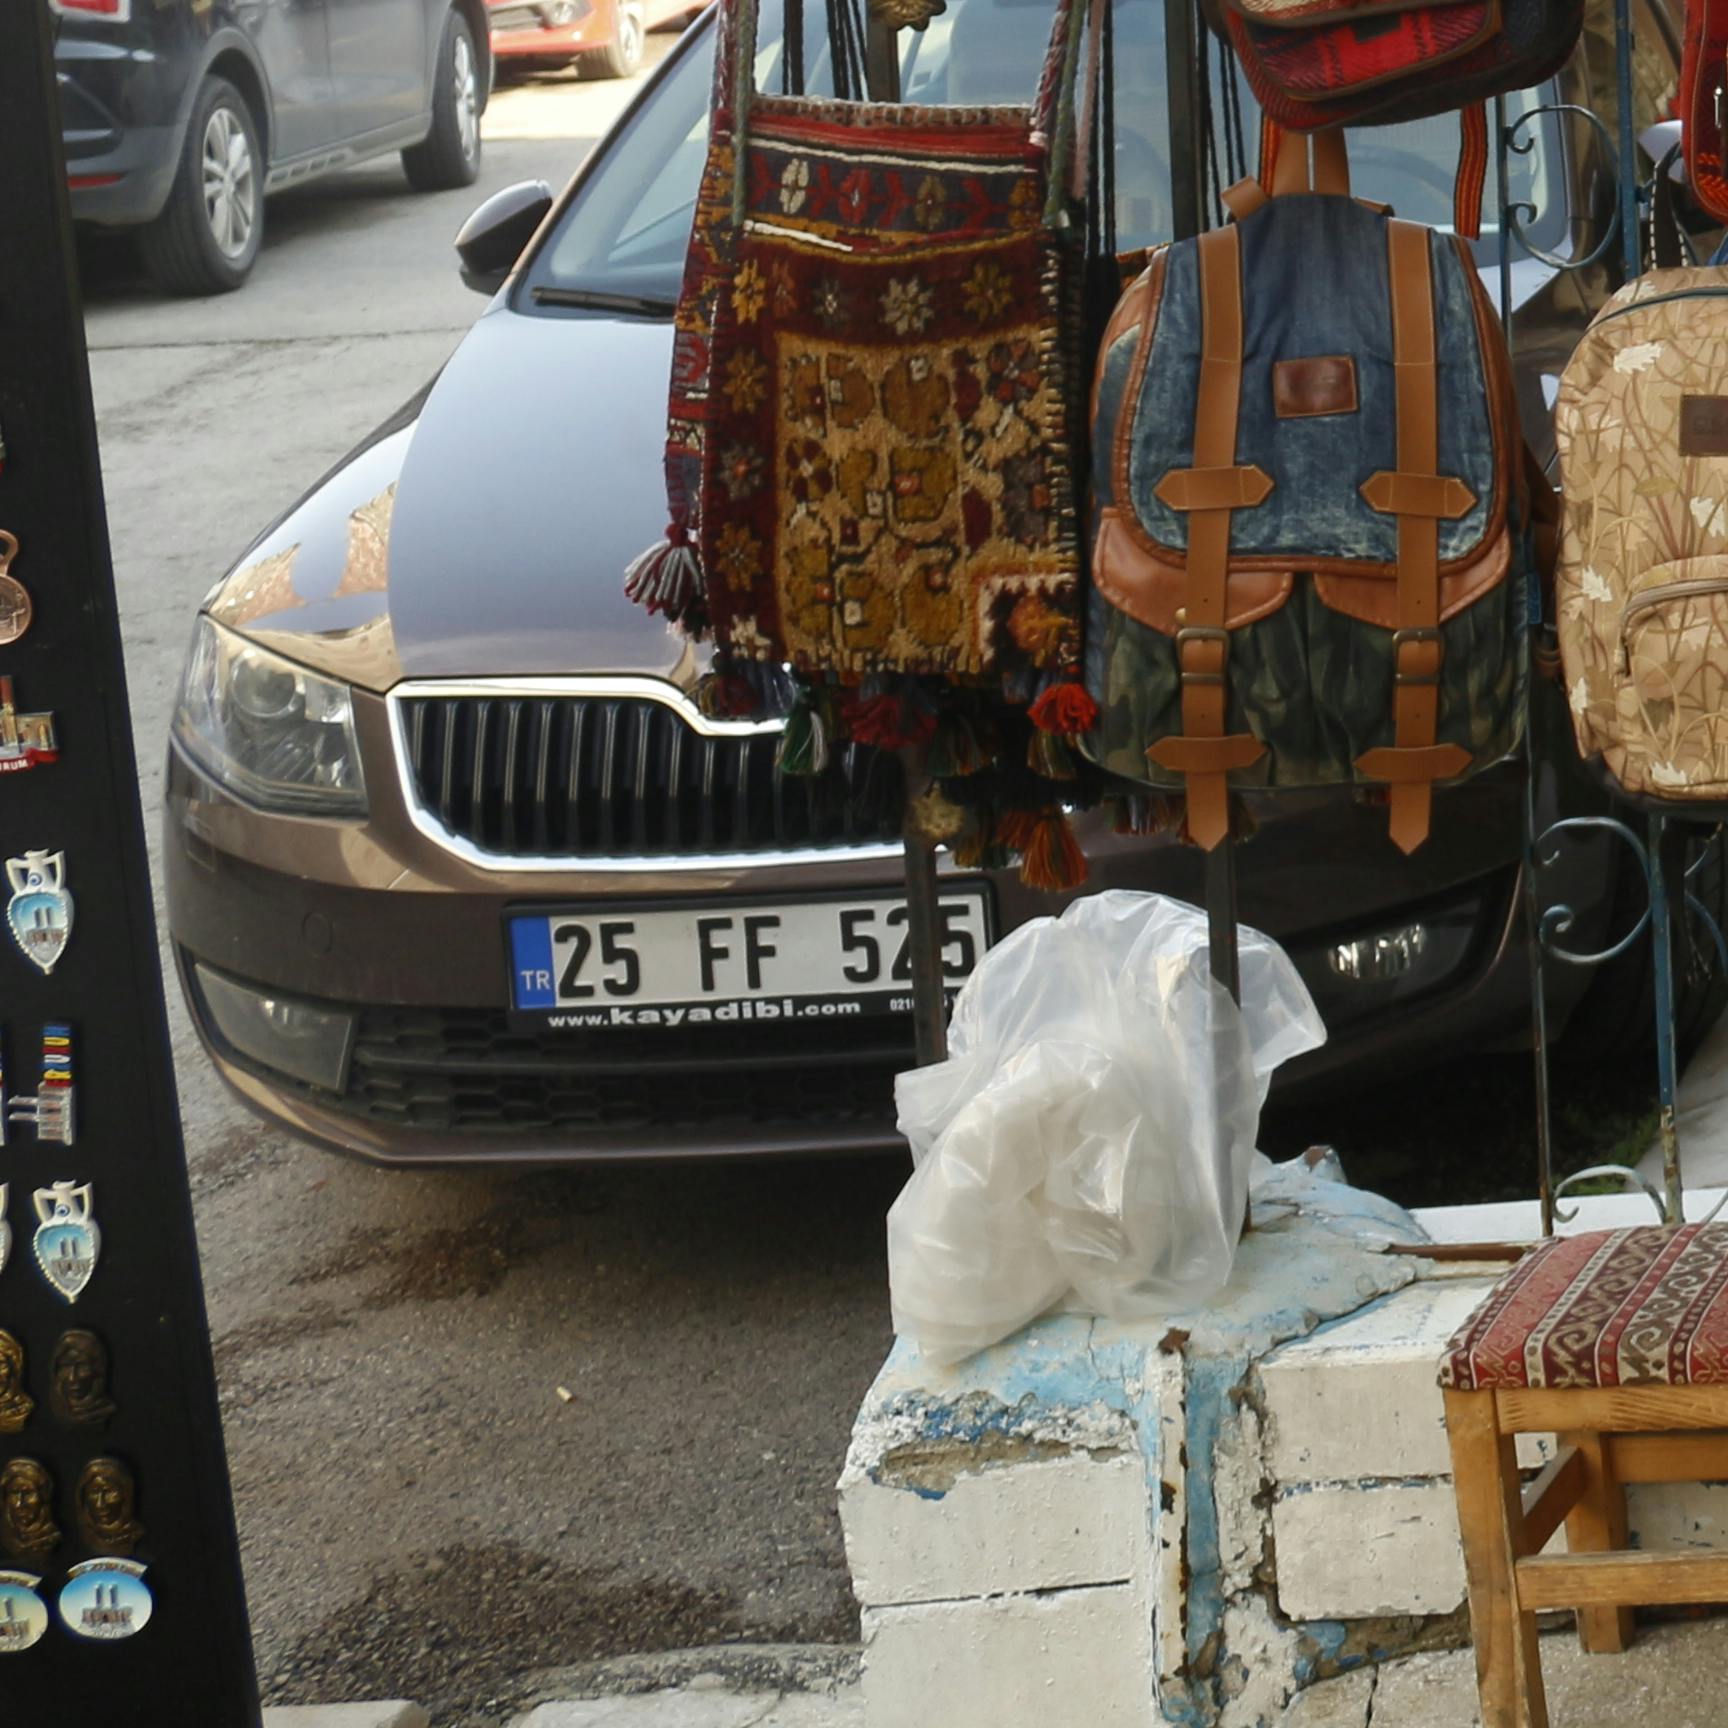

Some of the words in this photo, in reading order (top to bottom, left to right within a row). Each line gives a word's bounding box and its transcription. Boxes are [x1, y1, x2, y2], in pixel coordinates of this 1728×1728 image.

[553, 921, 641, 999] 25
[696, 915, 781, 992] FF
[839, 903, 976, 984] 525
[521, 969, 551, 991] TR
[548, 998, 861, 1028] www.kayadibi.com
